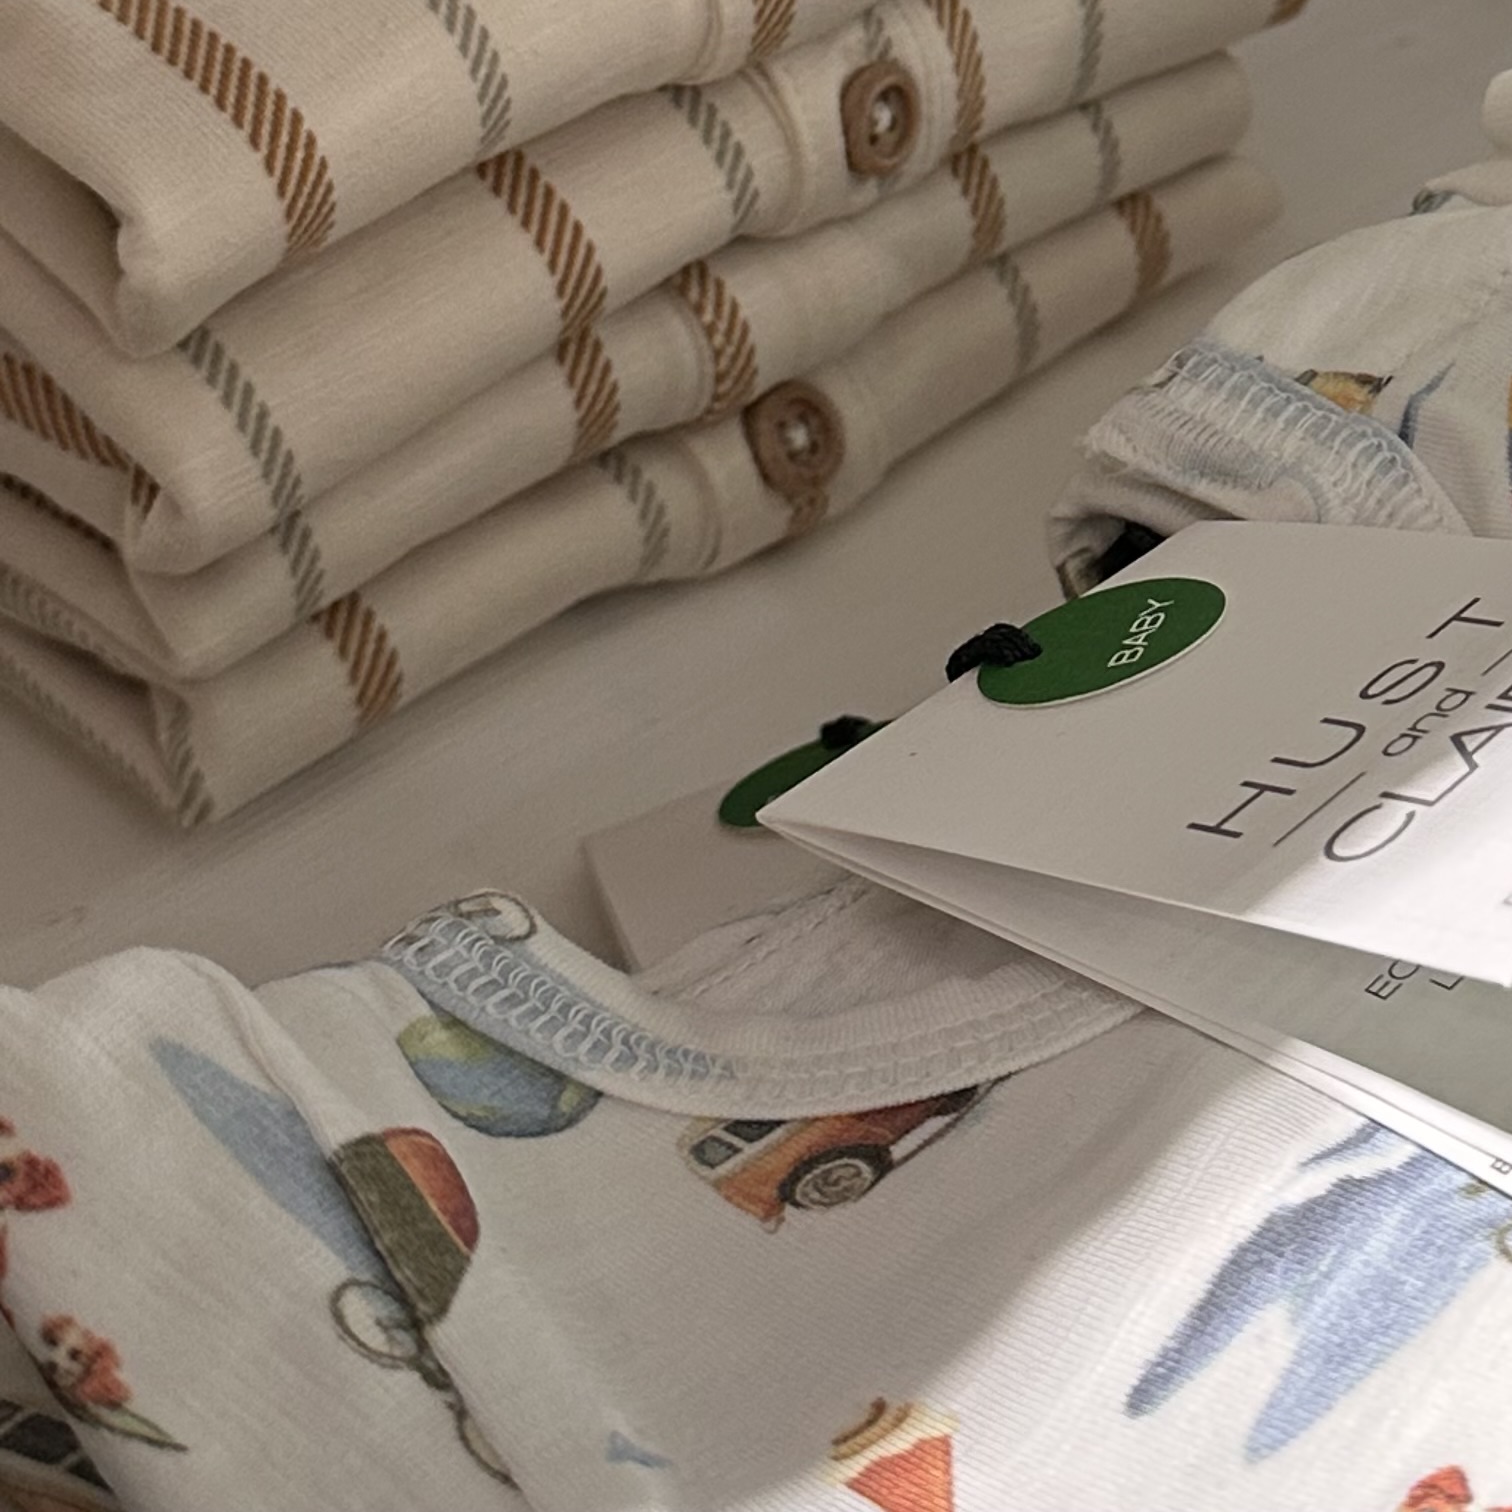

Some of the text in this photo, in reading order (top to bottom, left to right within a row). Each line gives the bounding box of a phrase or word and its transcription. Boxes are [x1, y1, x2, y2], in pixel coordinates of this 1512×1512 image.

[1107, 598, 1174, 668] BABY
[1186, 597, 1506, 840] HUST
[1382, 687, 1477, 758] and
